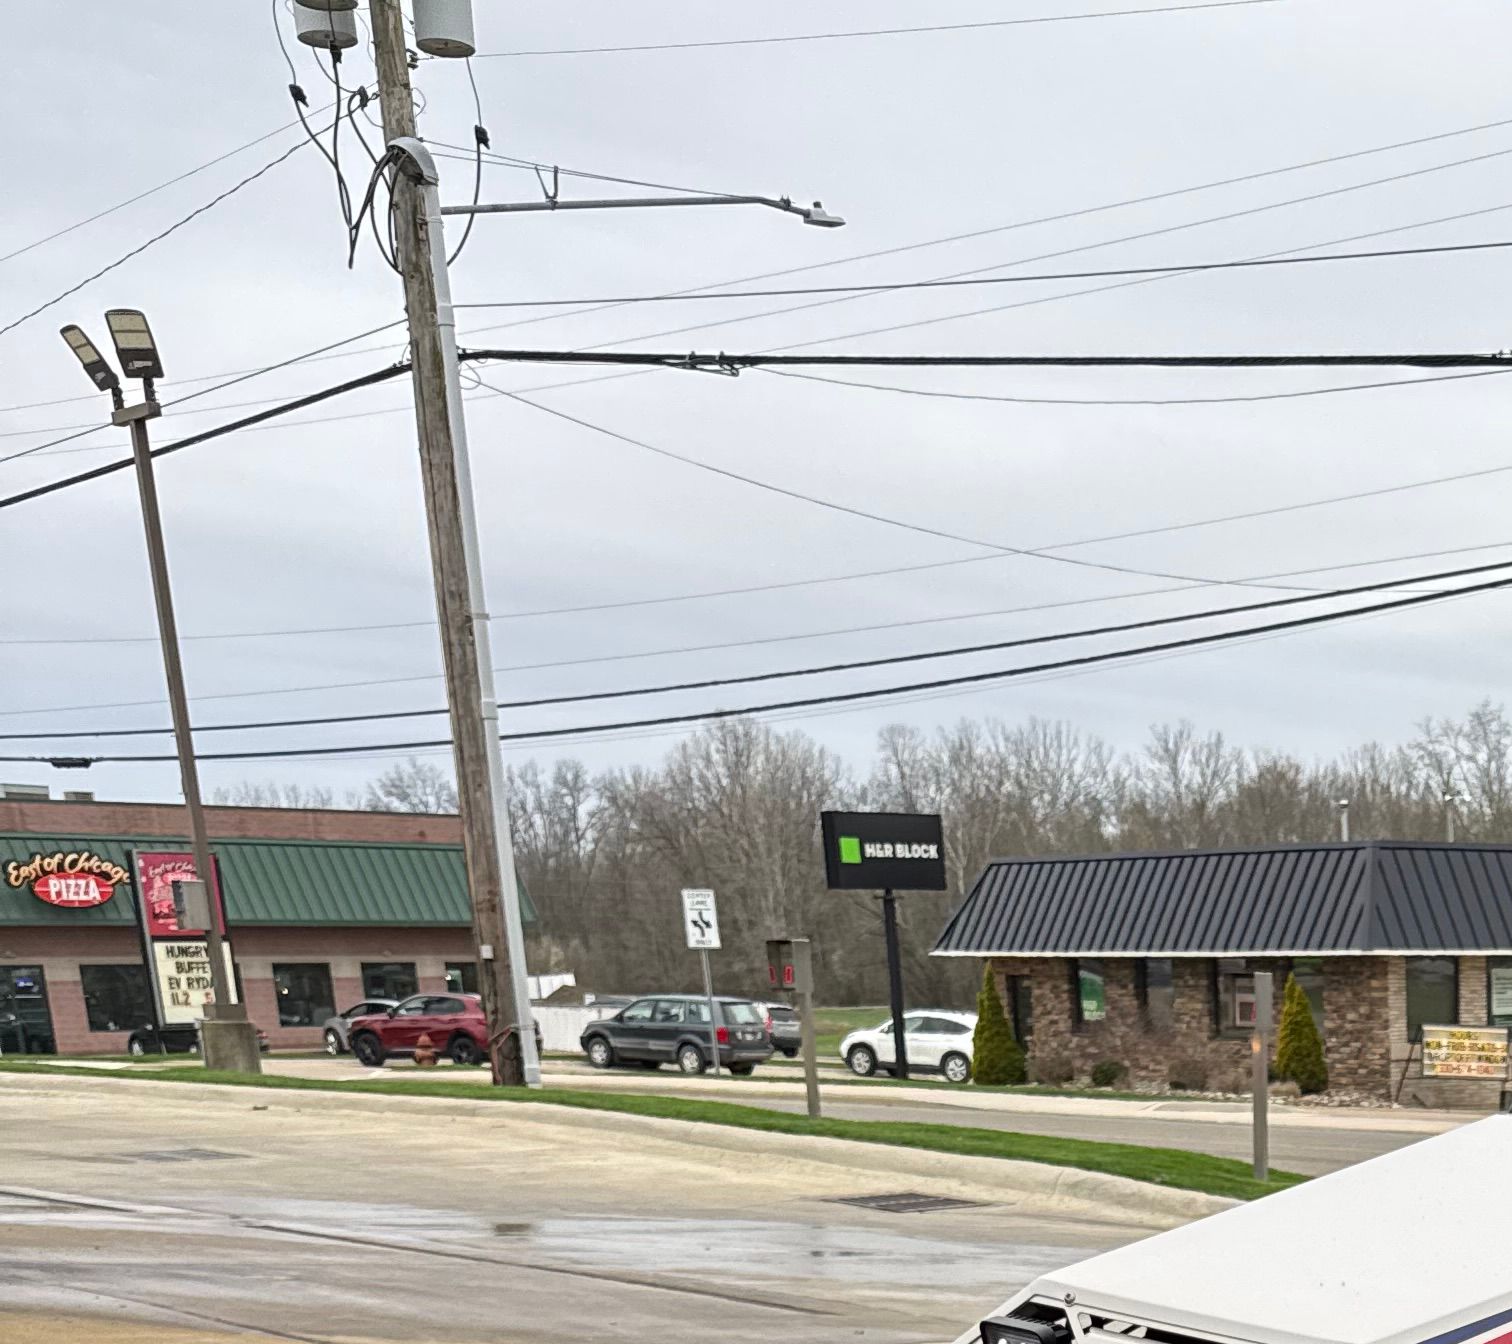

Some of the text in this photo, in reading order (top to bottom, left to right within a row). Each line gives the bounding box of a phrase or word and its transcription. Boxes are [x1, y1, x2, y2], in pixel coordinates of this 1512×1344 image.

[895, 843, 939, 859] BLOCK
[8, 854, 43, 887] East
[43, 852, 64, 874] of
[48, 879, 101, 901] PIZZA
[175, 960, 211, 974] BUFFE
